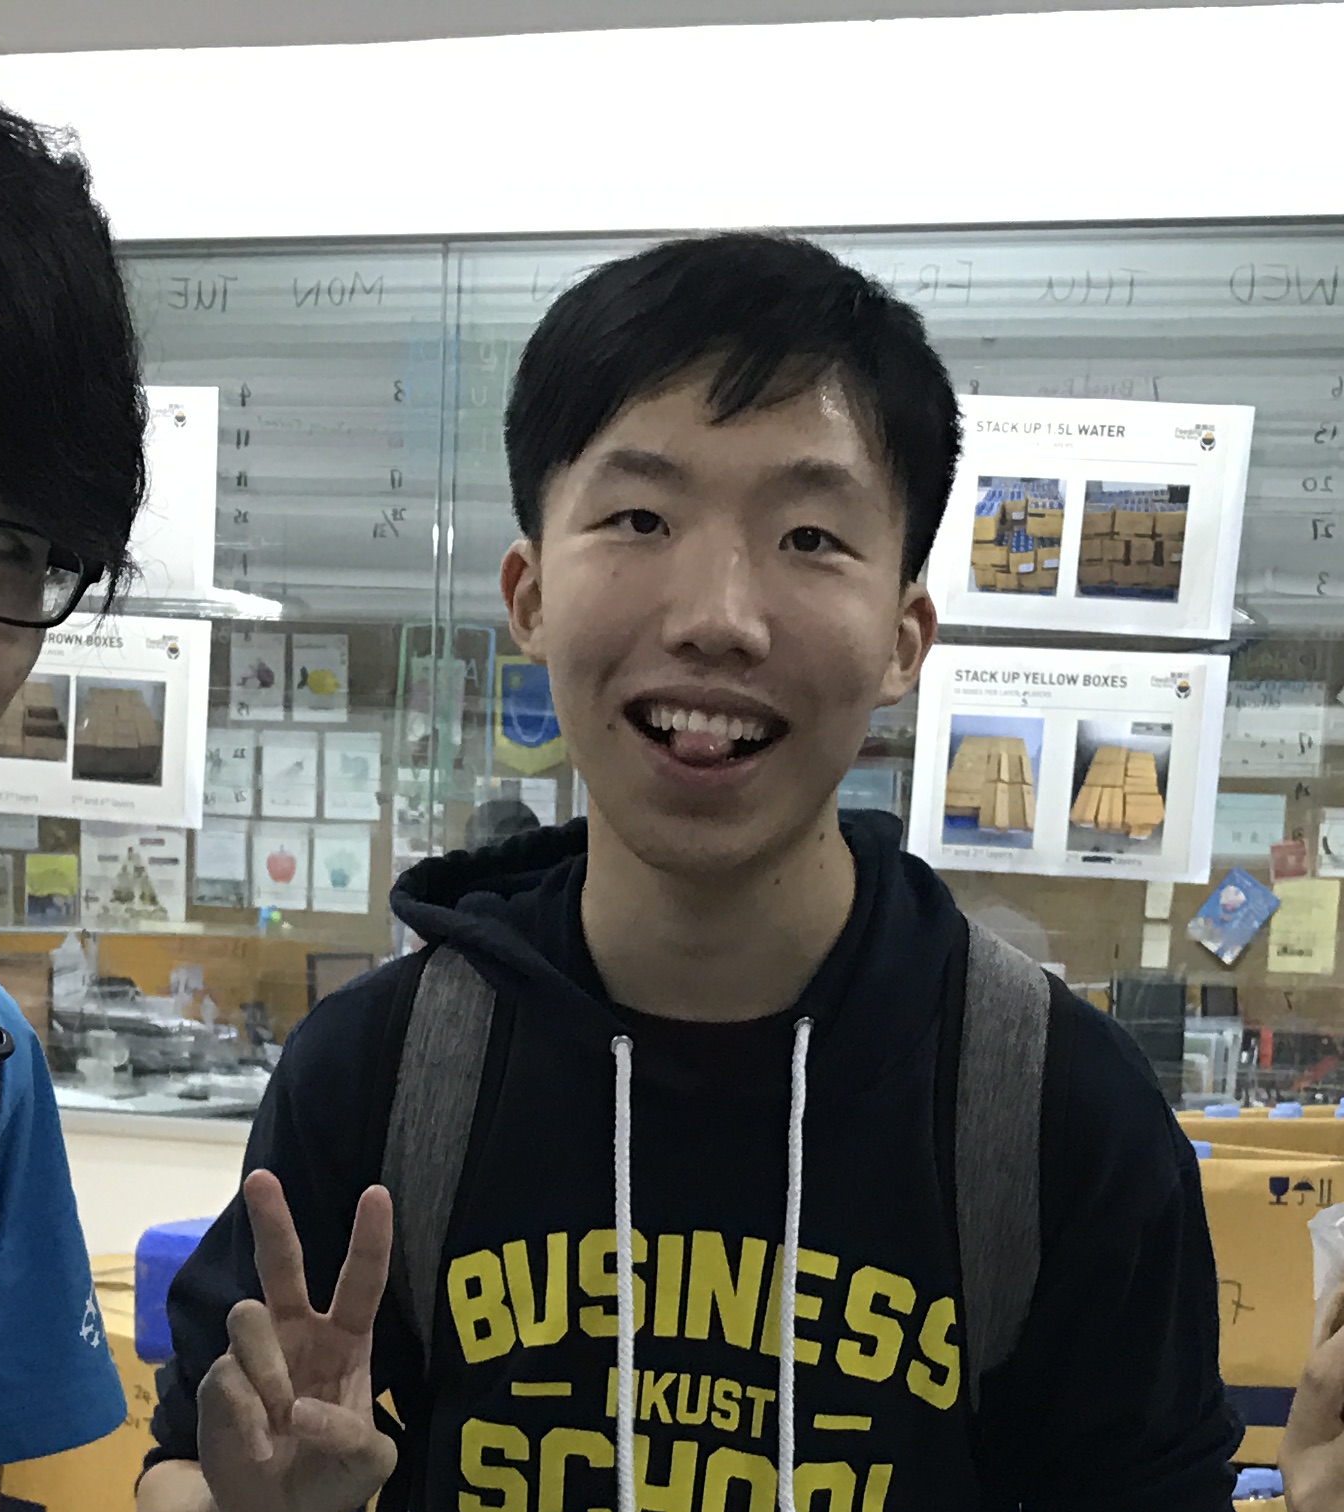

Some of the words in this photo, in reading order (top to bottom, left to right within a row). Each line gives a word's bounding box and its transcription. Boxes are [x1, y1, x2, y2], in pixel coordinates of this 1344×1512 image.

[976, 420, 1019, 434] STACK
[1023, 422, 1042, 434] UP
[1047, 423, 1073, 436] 1.5L
[1077, 424, 1126, 438] WATER
[85, 635, 124, 649] BOXES
[954, 669, 998, 684] STACK
[1001, 671, 1020, 685] UP
[1022, 671, 1079, 687] YELLOW
[1083, 674, 1128, 689] BOXES
[446, 1228, 960, 1410] BUSINESS
